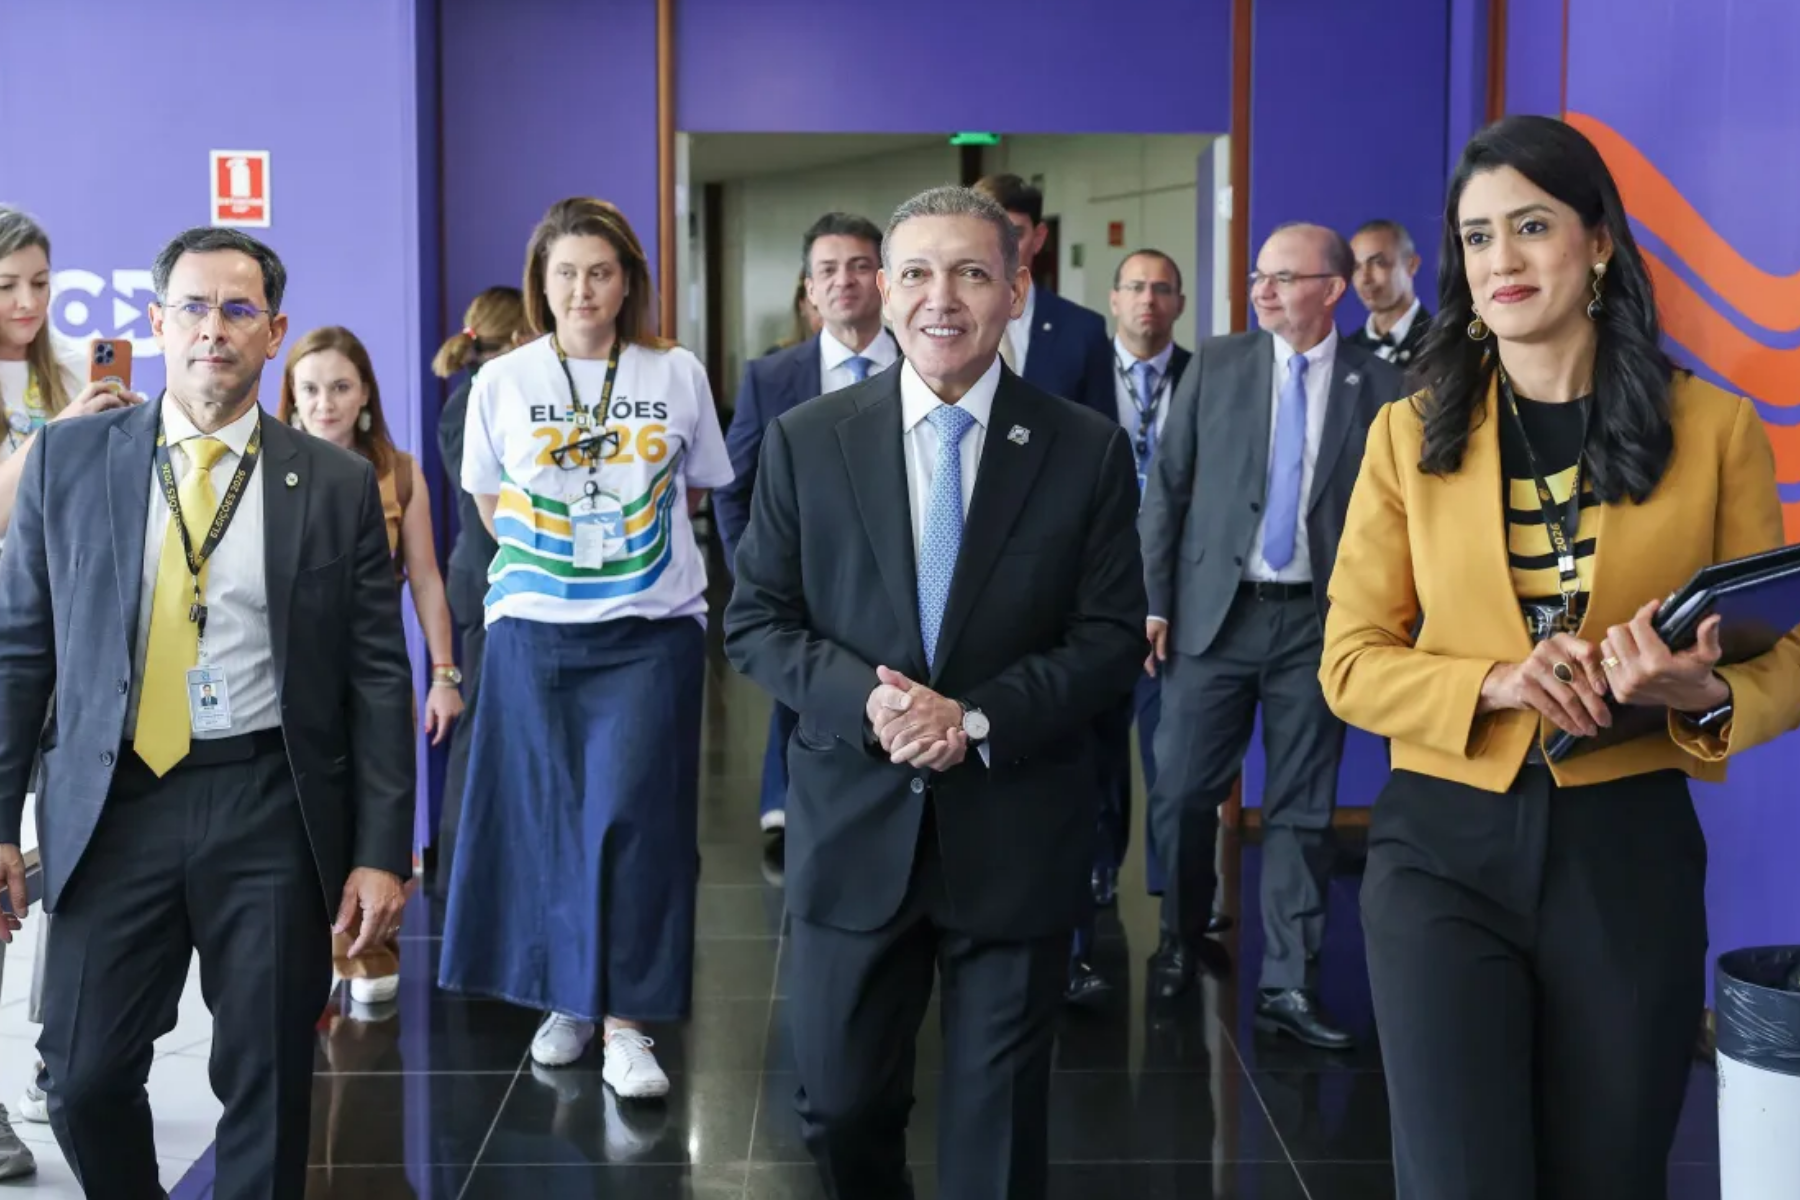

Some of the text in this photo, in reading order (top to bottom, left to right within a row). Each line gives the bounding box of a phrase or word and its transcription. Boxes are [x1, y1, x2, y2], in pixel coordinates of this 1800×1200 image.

[210, 470, 246, 539] ELEIÇÕES 2026
[1550, 522, 1568, 553] 2026
